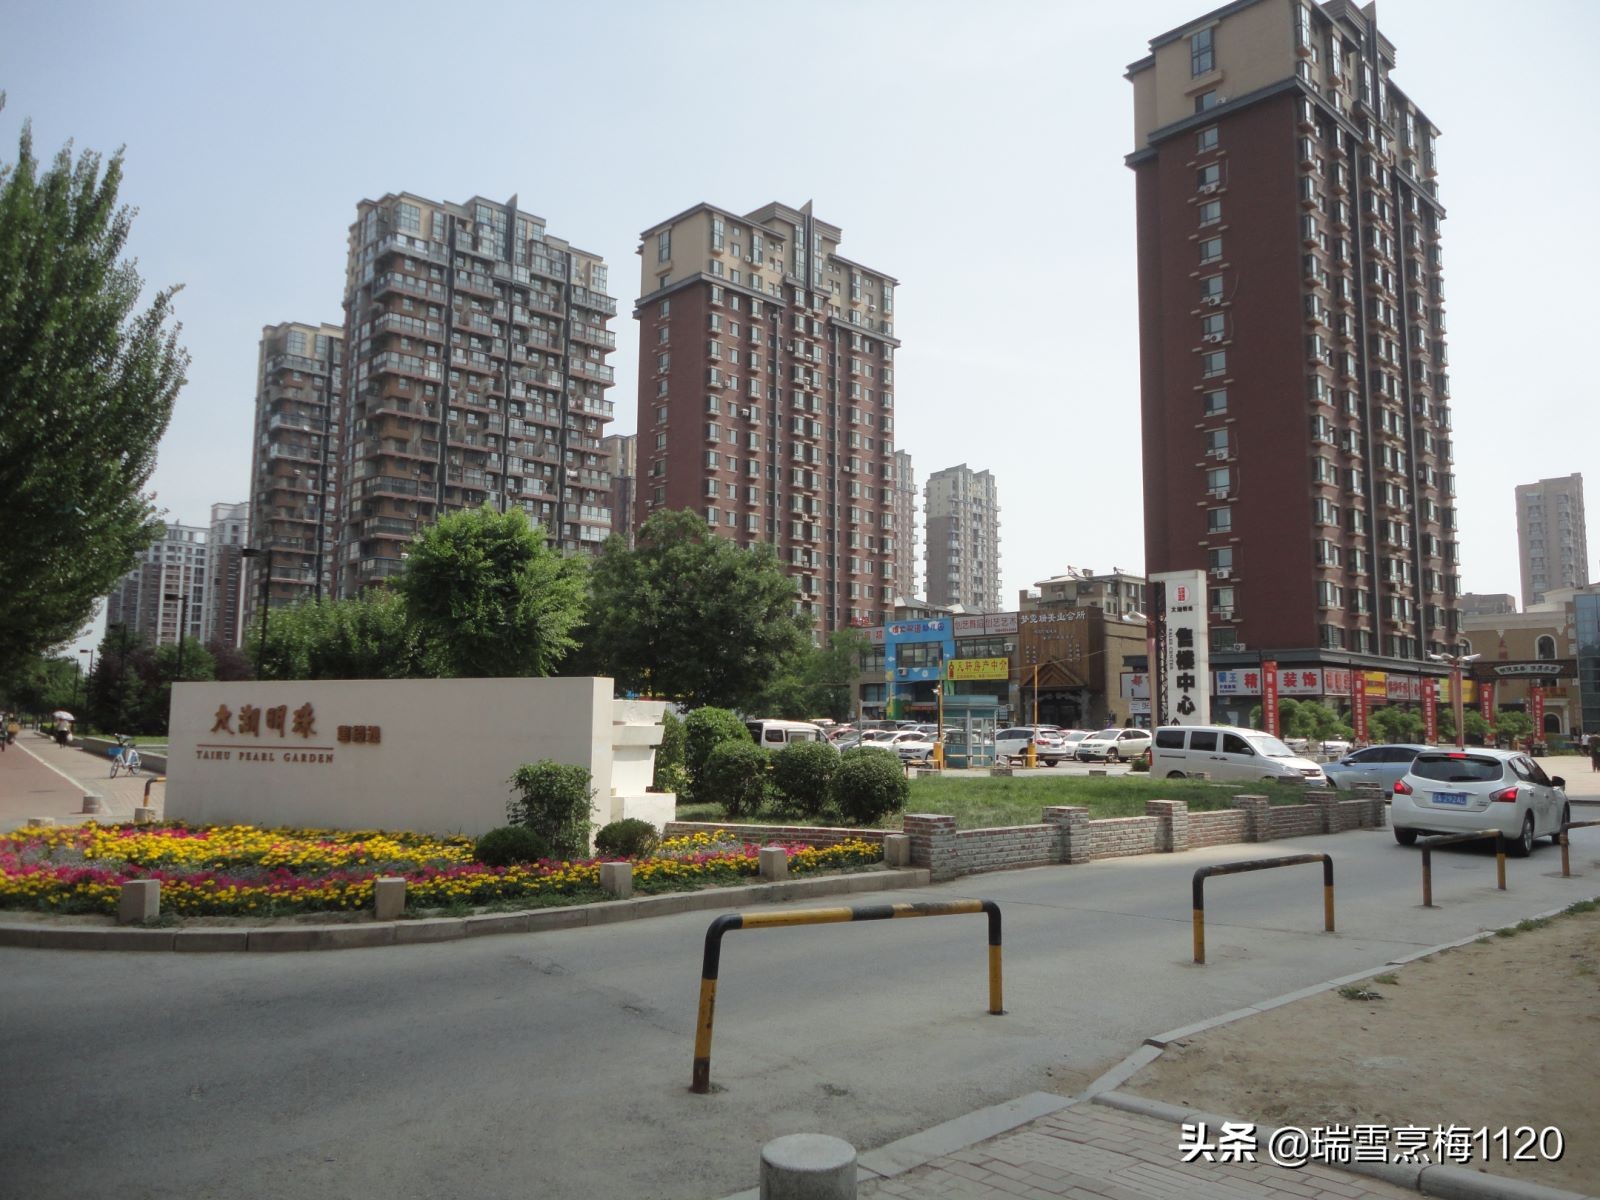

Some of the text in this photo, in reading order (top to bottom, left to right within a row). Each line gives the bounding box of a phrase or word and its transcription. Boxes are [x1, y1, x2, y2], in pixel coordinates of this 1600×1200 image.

[196, 750, 334, 764] TAIHU PEARL GARDEN
